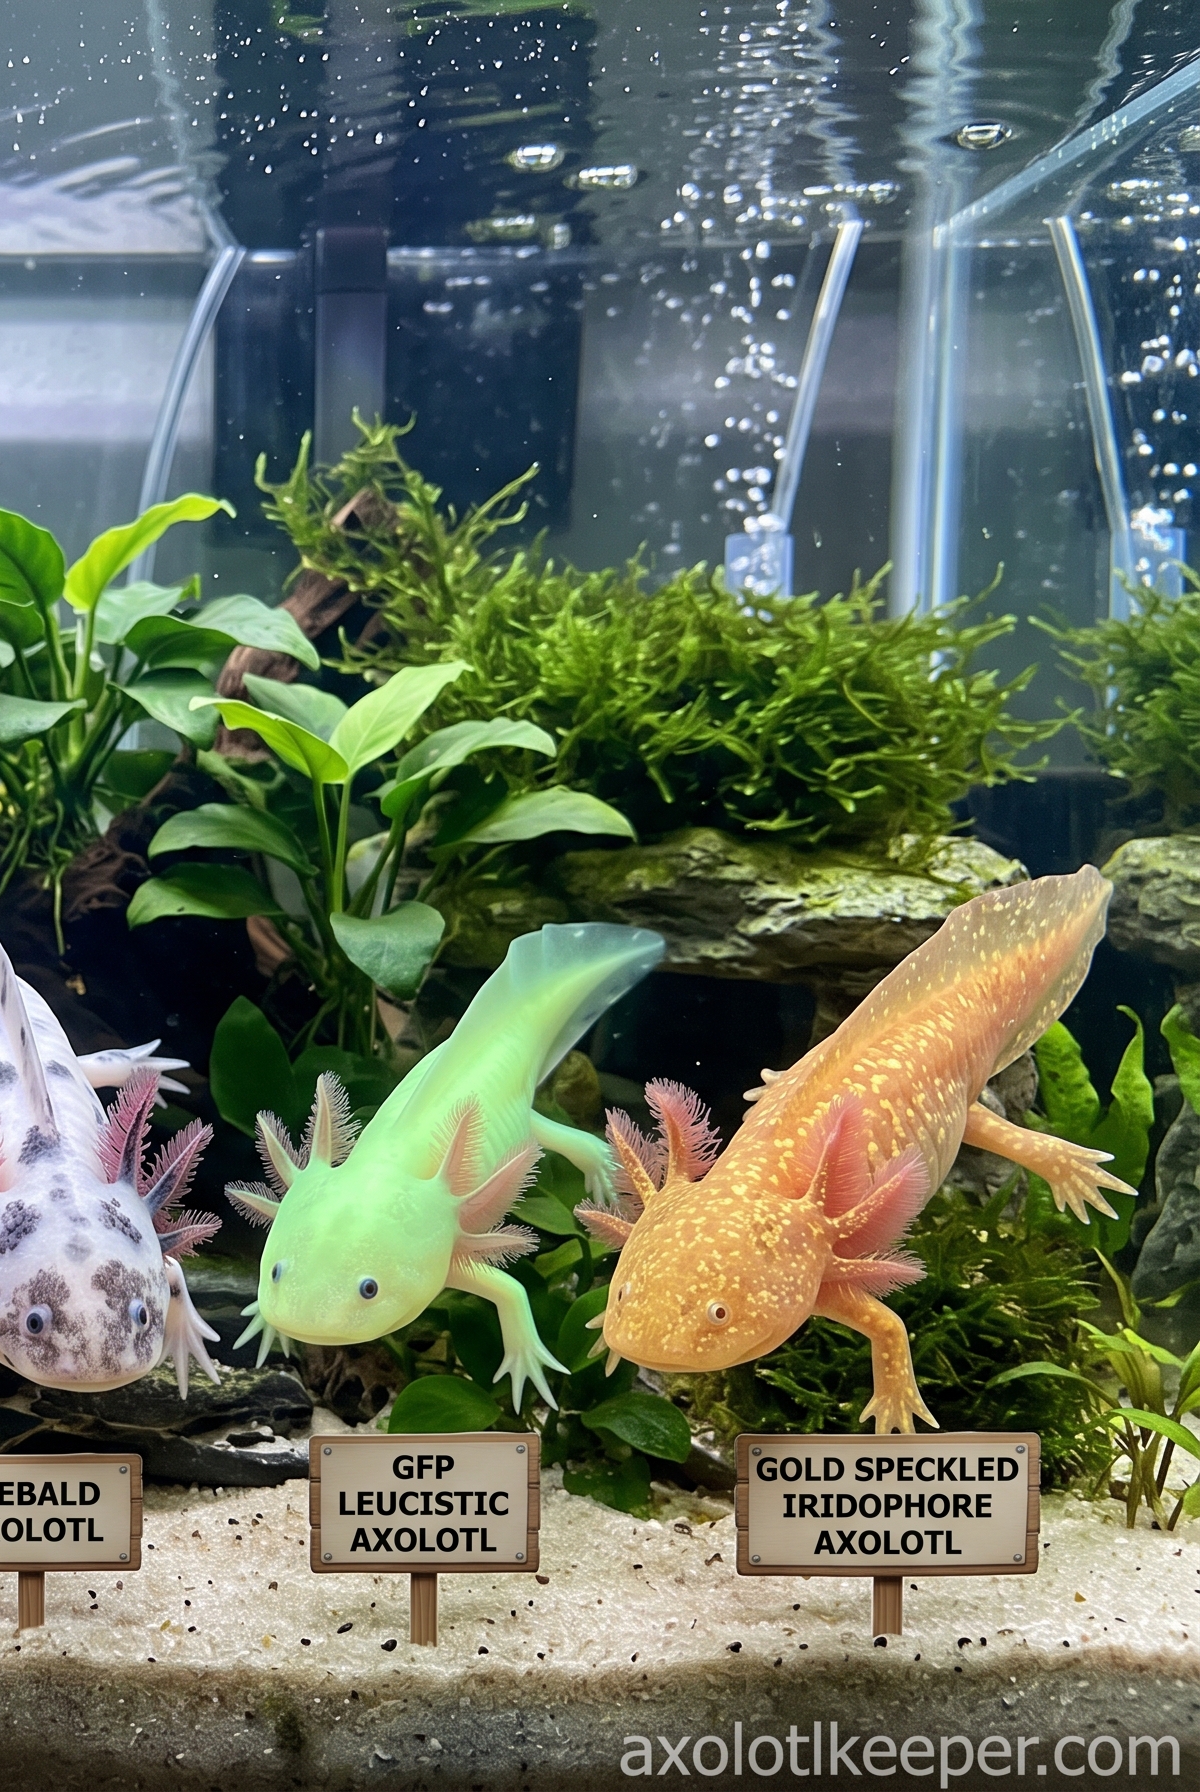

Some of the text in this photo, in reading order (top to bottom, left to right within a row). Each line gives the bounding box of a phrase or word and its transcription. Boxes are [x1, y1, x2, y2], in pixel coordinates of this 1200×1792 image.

[392, 1455, 455, 1479] GFP
[756, 1457, 1019, 1481] GOLD SPECKLED
[339, 1491, 509, 1515] LEUCISTIC
[783, 1494, 992, 1518] IRIDOPHORE
[349, 1528, 497, 1552] AXOLOTL
[813, 1530, 962, 1555] AXOLOTL
